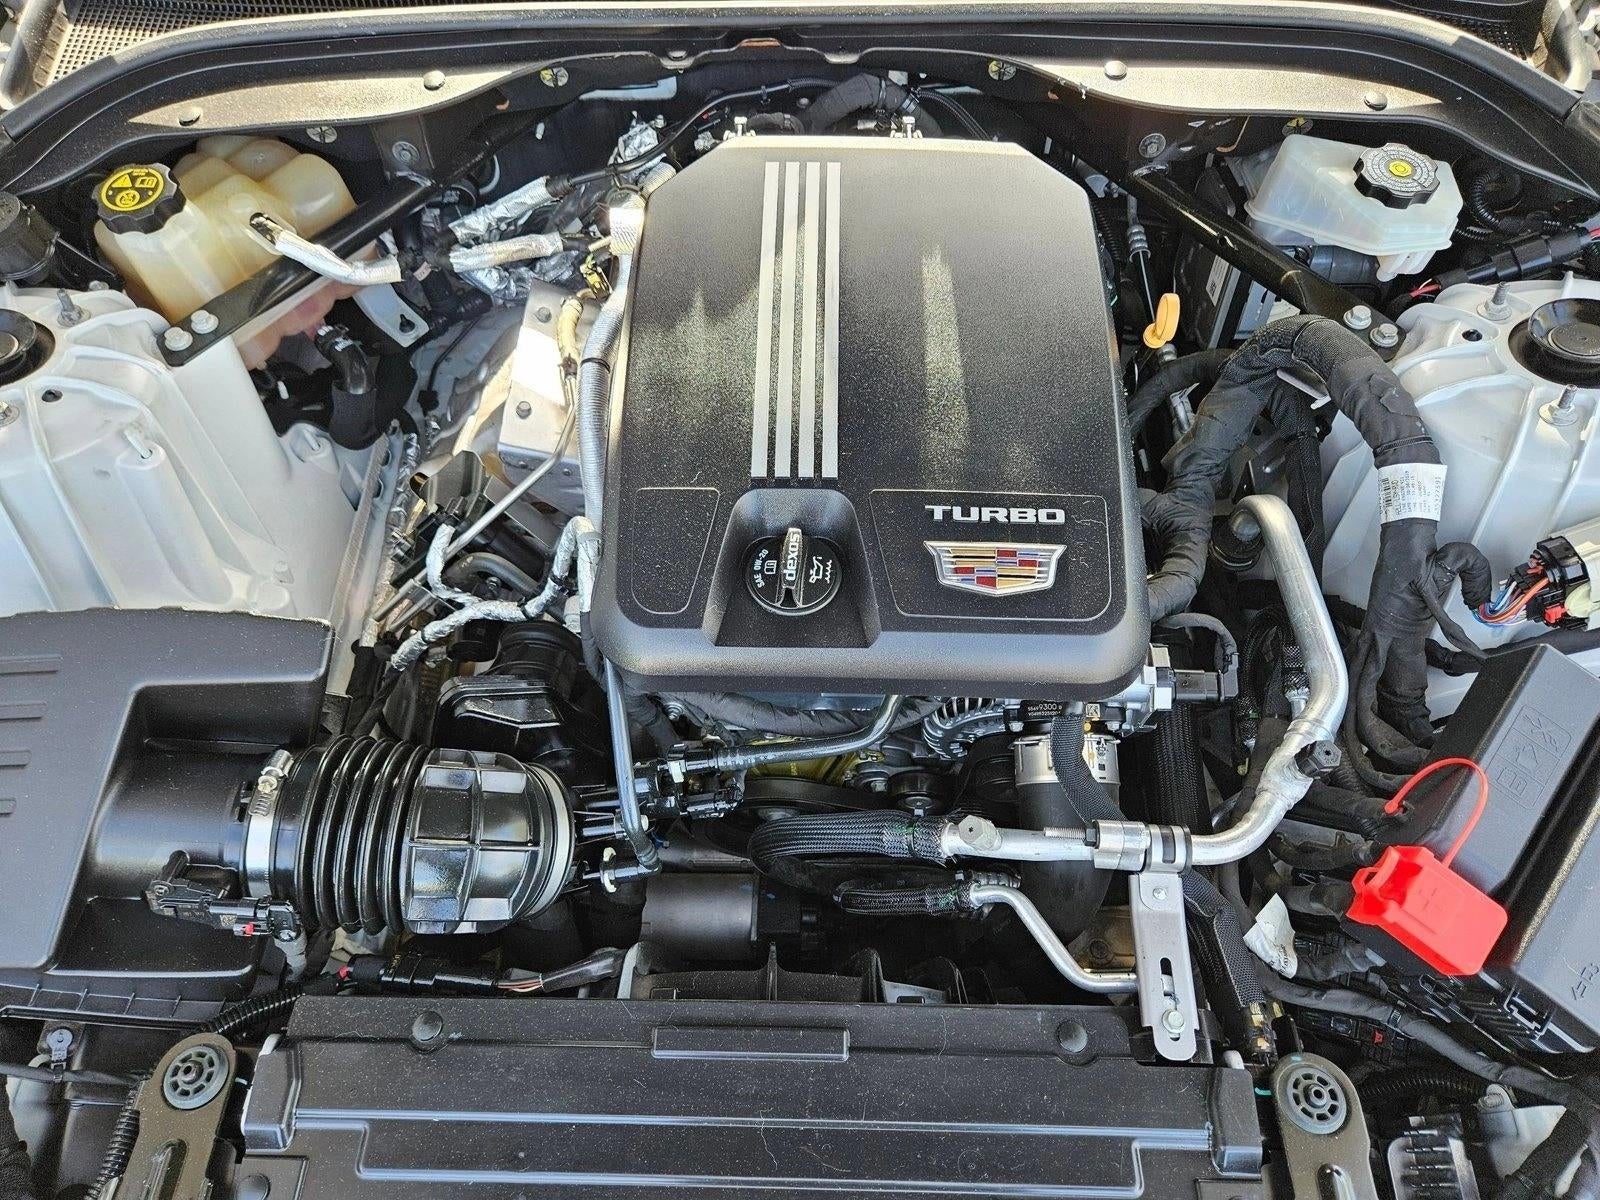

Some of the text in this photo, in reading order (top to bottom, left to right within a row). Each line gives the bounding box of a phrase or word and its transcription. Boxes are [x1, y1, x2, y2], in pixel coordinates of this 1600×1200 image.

[925, 505, 1065, 524] TURBO
[753, 549, 769, 588] SAE 0W-20
[783, 533, 800, 580] dexos
